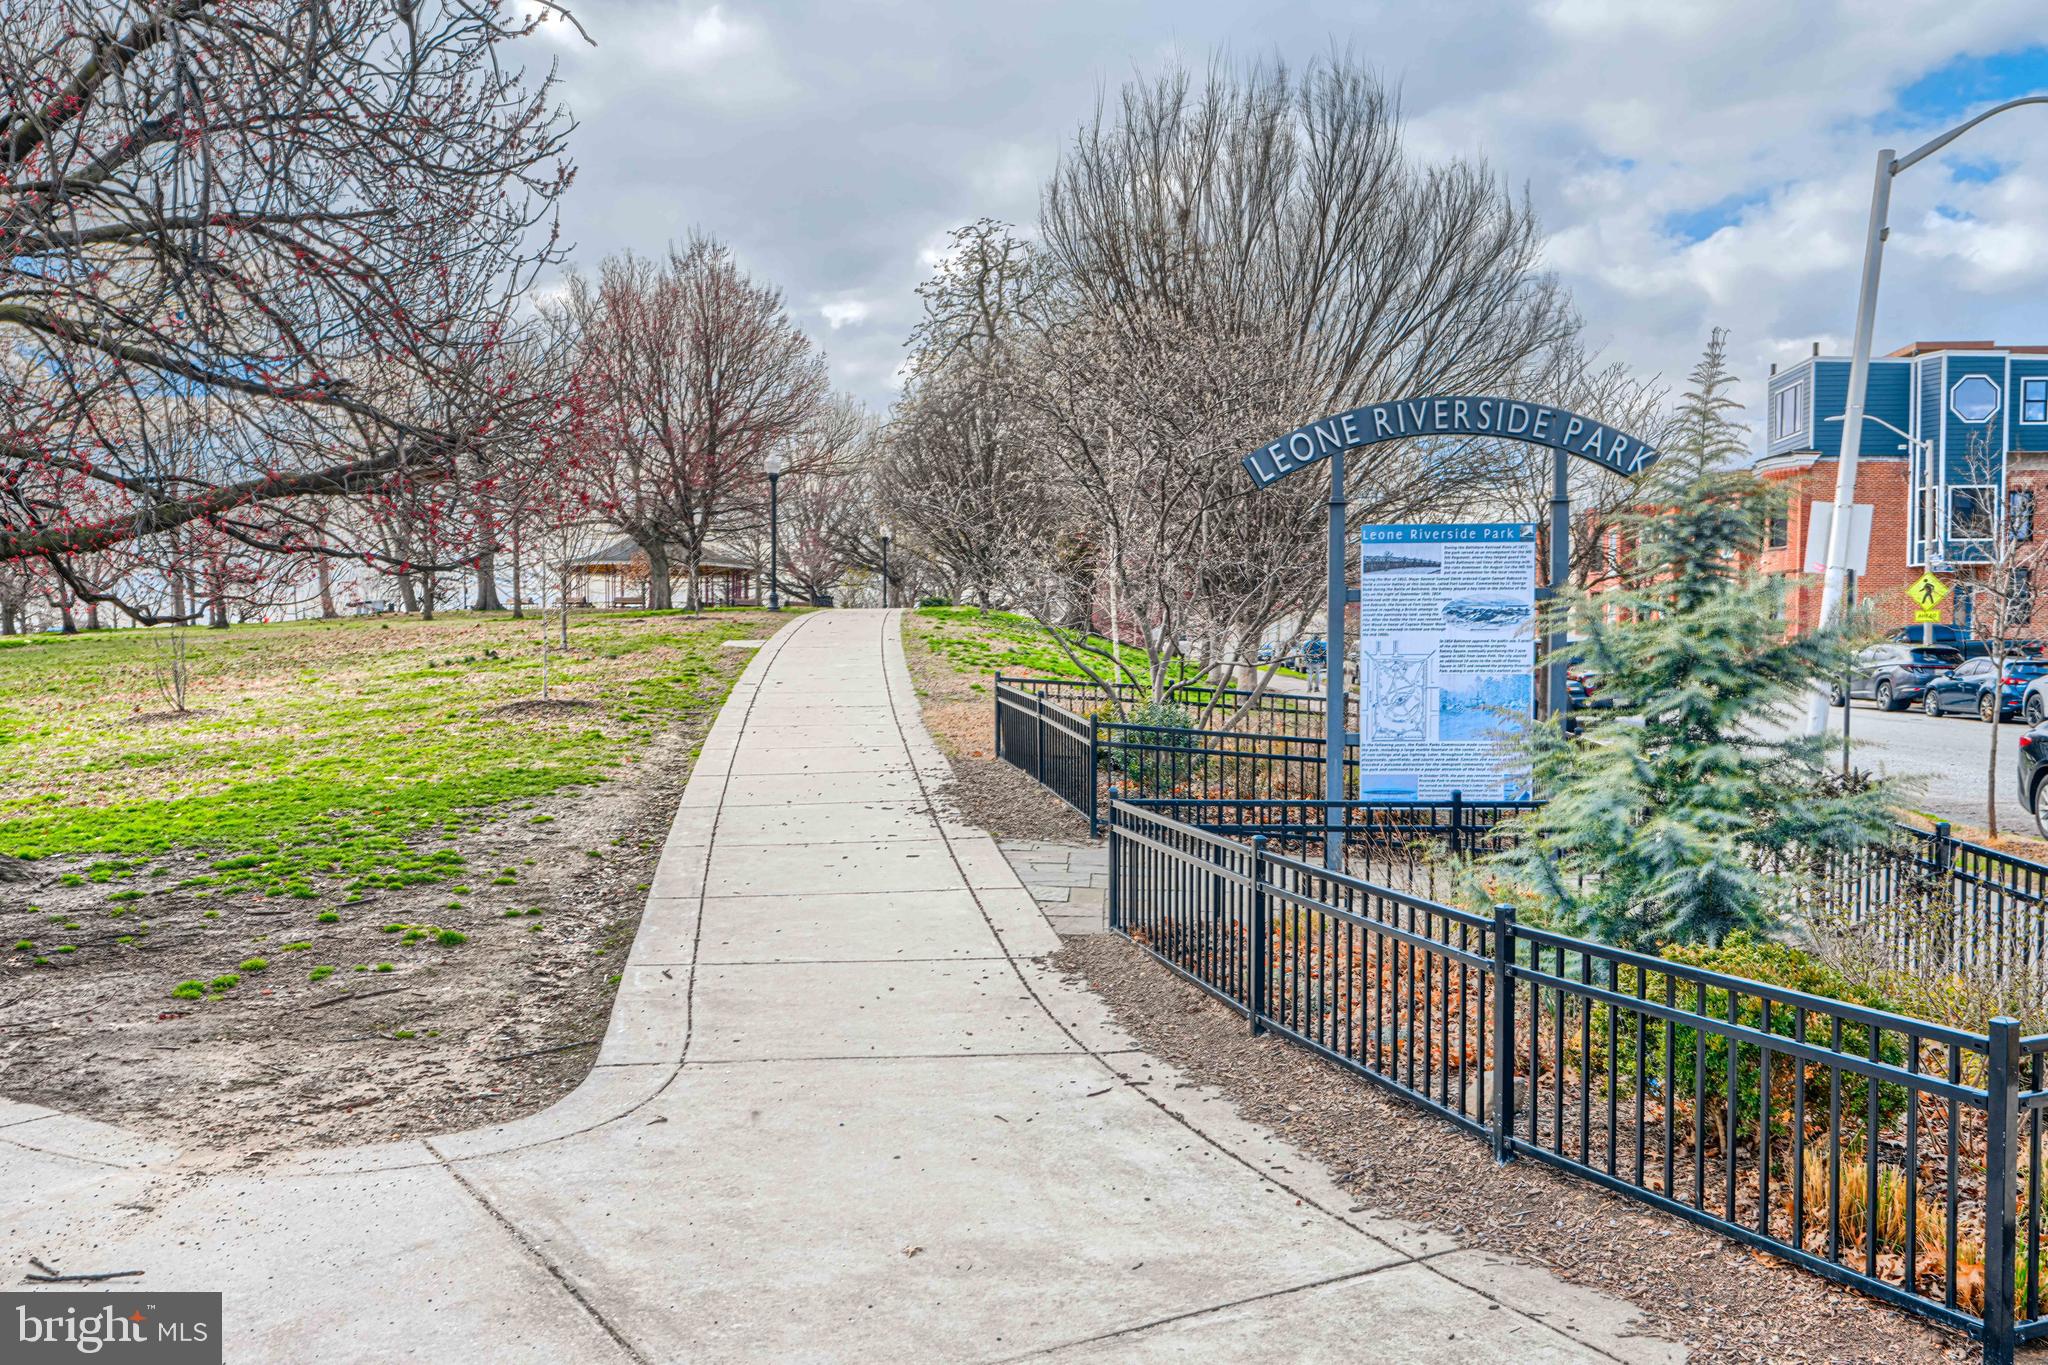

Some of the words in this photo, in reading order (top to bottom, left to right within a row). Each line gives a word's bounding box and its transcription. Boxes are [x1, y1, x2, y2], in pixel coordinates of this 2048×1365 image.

[1250, 414, 1360, 482] LEONE
[1373, 400, 1551, 438] RIVERSIDE
[1563, 407, 1655, 478] PARK
[1363, 529, 1403, 540] Leone
[1410, 528, 1477, 540] Riverside
[1484, 527, 1515, 539] Park
